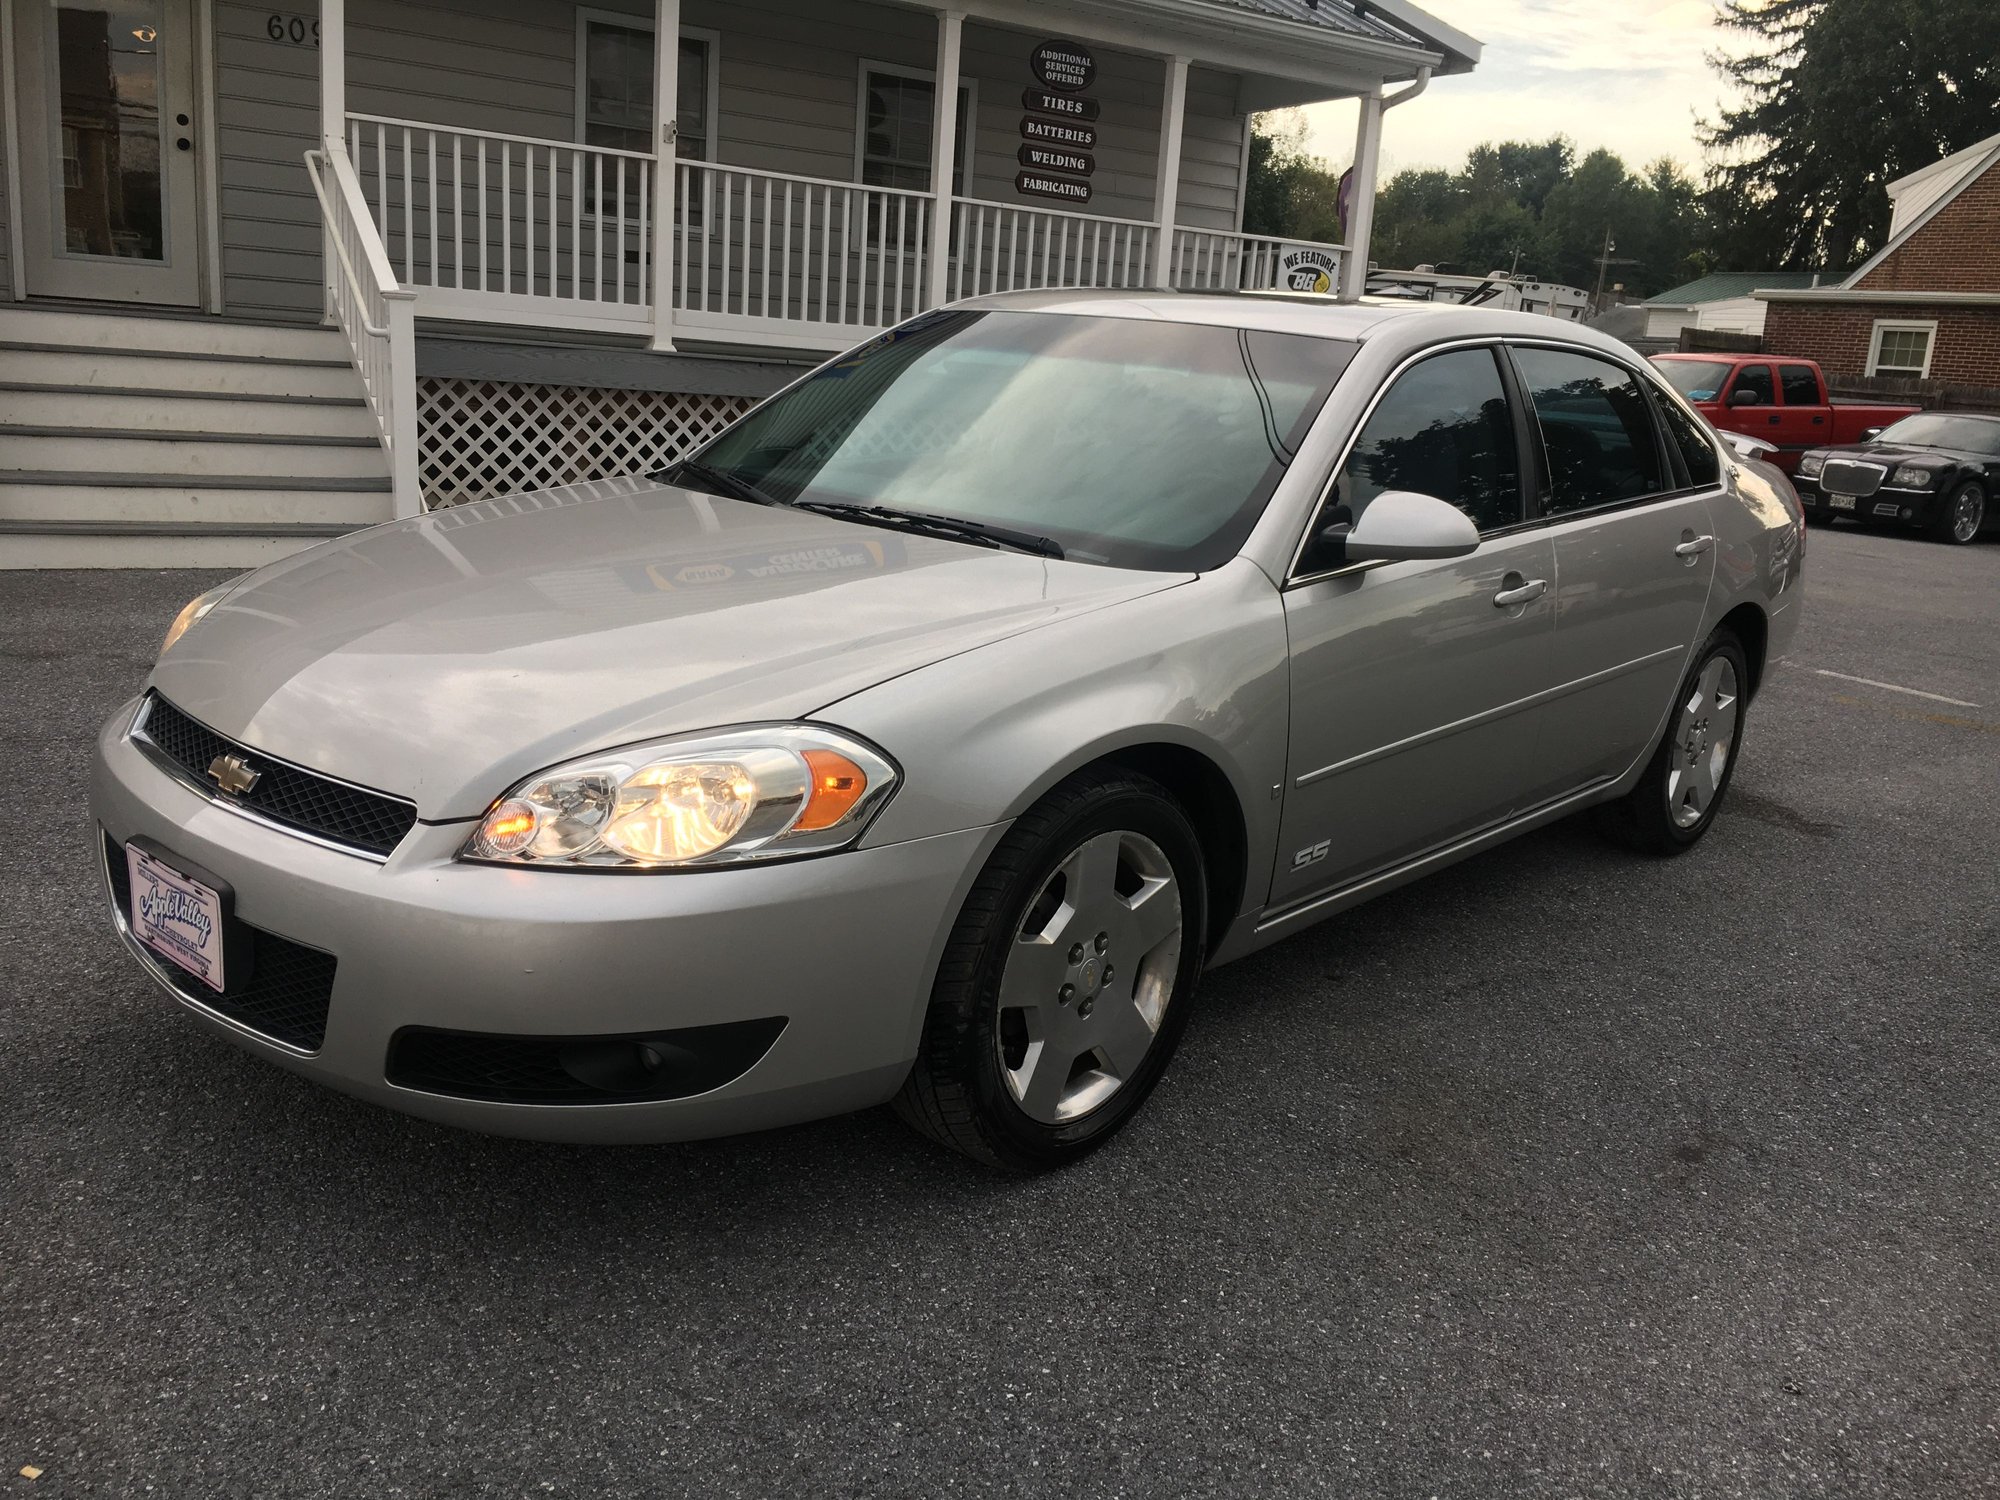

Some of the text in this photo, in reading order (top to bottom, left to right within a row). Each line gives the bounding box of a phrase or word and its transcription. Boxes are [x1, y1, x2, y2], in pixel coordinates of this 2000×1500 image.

[1040, 49, 1092, 67] ADDITIONAL
[1045, 61, 1086, 76] SERVICES
[1046, 71, 1084, 85] OFFERED
[1042, 95, 1083, 114] TIRES
[1027, 122, 1092, 144] BATTERIES
[1031, 150, 1085, 170] WELDING
[1023, 177, 1088, 197] FABRICATING
[1283, 251, 1336, 273] WE FEATURE
[1292, 272, 1317, 290] BG
[140, 884, 212, 949] Apple Valley
